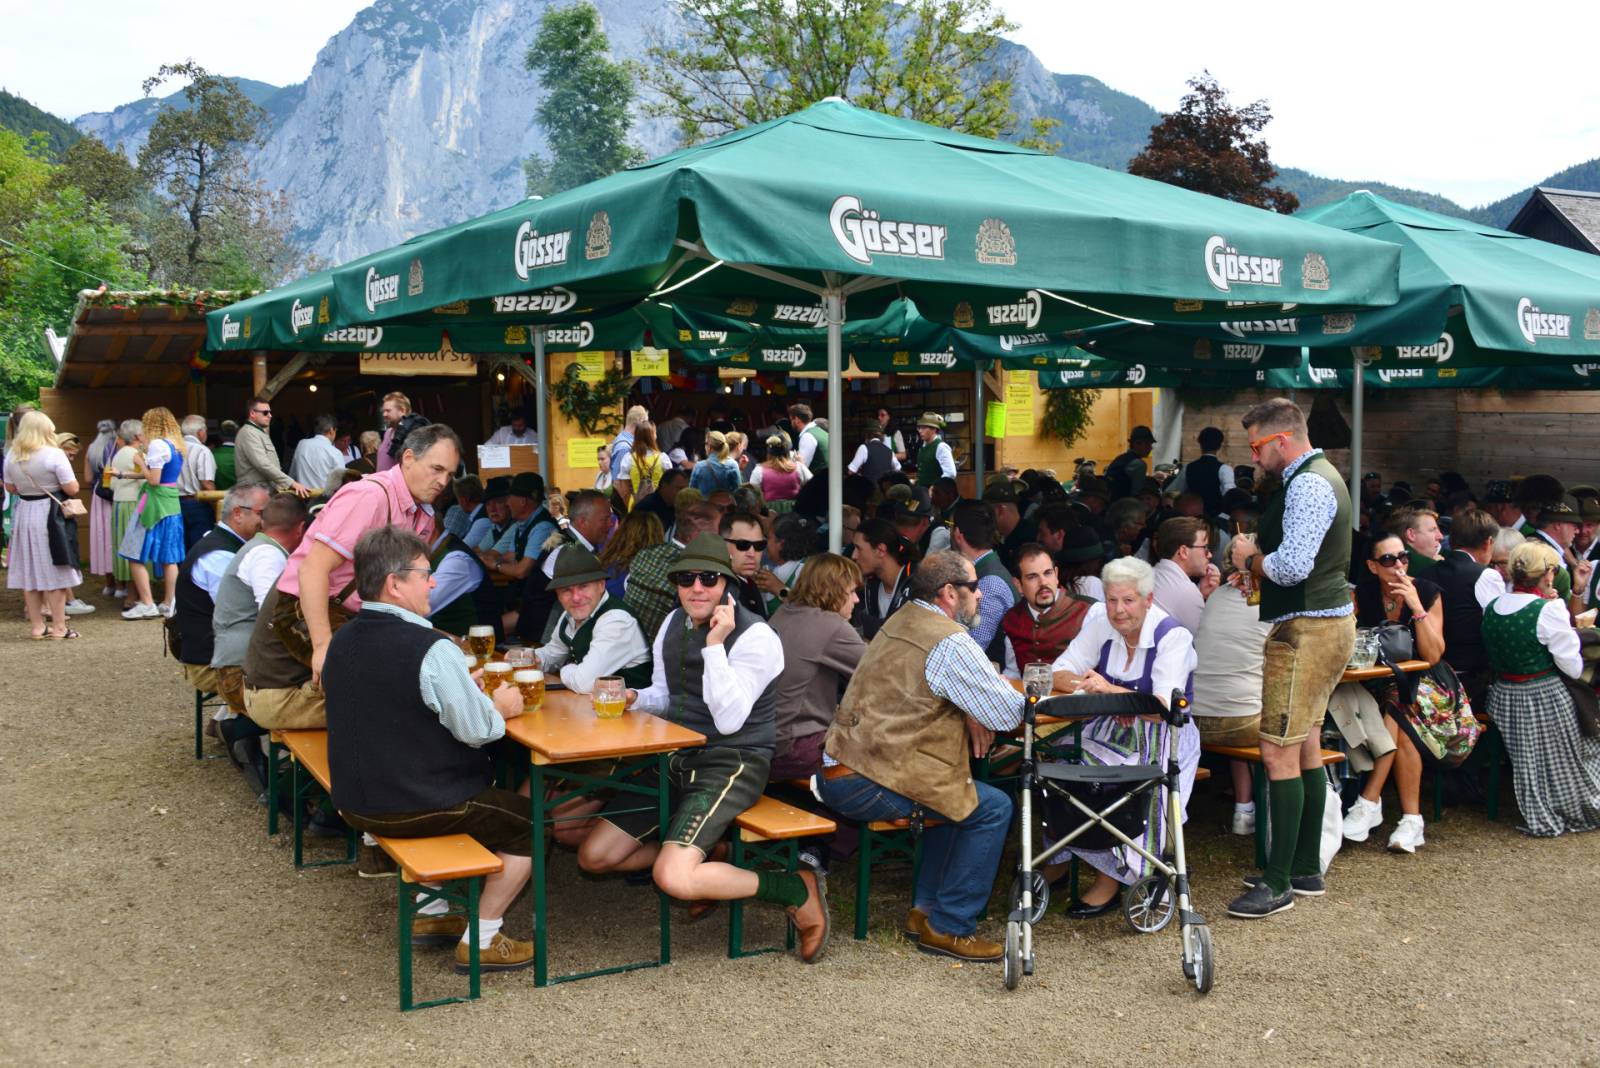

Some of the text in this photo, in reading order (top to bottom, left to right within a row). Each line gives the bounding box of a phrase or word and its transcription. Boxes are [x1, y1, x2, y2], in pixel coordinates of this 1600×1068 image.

[515, 221, 571, 281] Gösser
[829, 195, 947, 264] Gösser
[366, 267, 399, 313] Gösser
[1205, 235, 1283, 291] Gösser
[1517, 297, 1570, 343] Gösser
